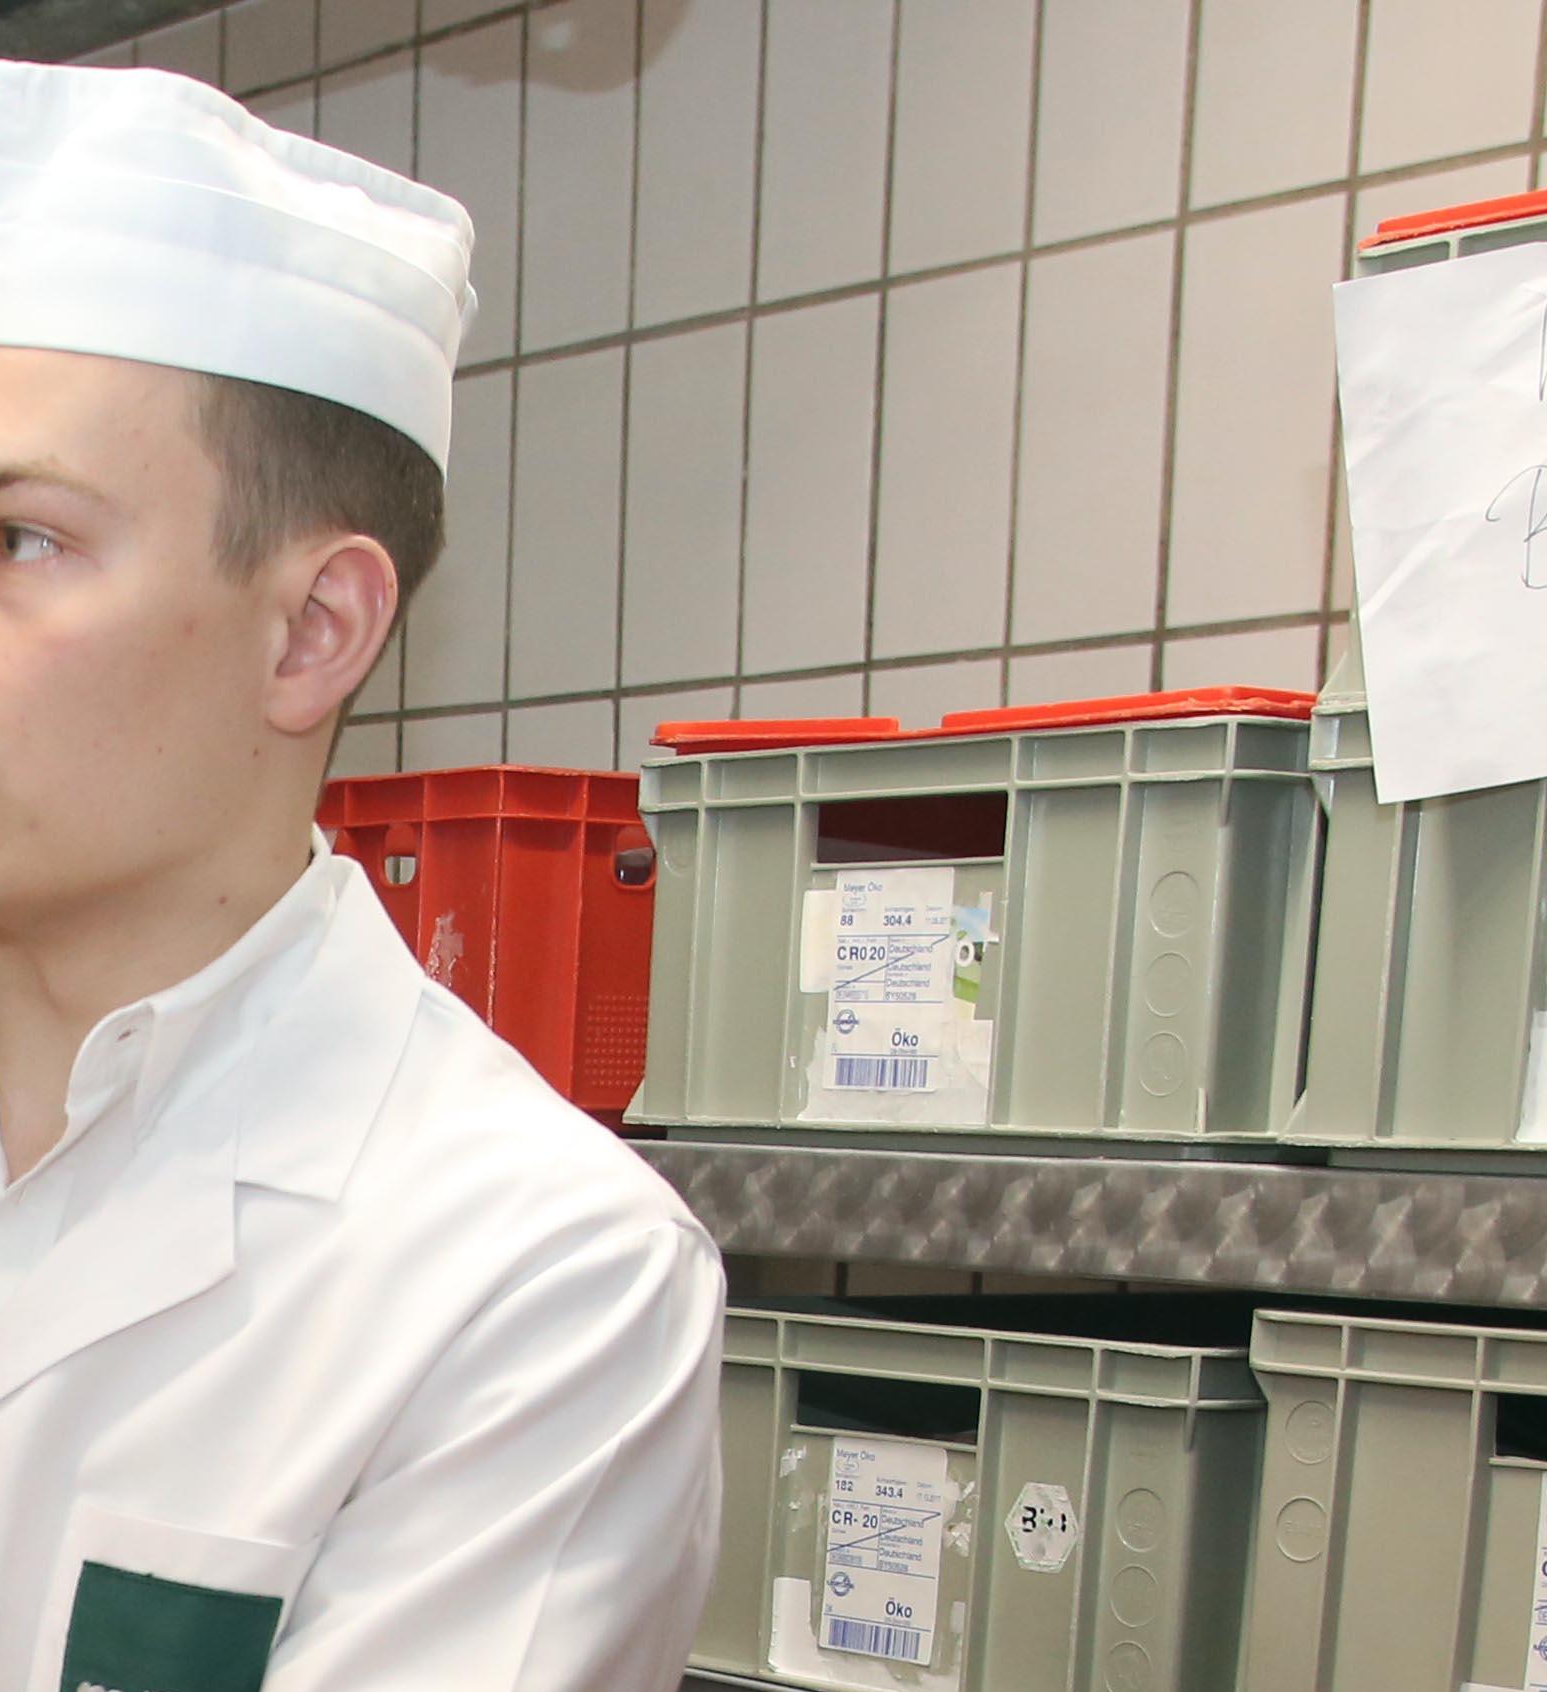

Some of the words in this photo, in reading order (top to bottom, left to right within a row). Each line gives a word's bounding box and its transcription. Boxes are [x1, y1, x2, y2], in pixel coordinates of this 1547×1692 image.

[842, 882, 865, 894] Meyer
[867, 880, 883, 892] Öko
[840, 914, 854, 926] 88
[883, 914, 912, 926] 304.4
[889, 943, 933, 954] Deutschland
[887, 962, 931, 972] Deutschland
[885, 978, 930, 988] Deutschland
[891, 1027, 919, 1048] Öko
[836, 1450, 859, 1462] Meyer
[835, 1480, 853, 1492] 182
[875, 1485, 904, 1498] 343.4
[862, 1514, 879, 1529] 20
[881, 1514, 924, 1528] Deutschland
[879, 1533, 923, 1546] Deutschland
[878, 1547, 922, 1562] Deutschland
[885, 1596, 913, 1618] Öko
